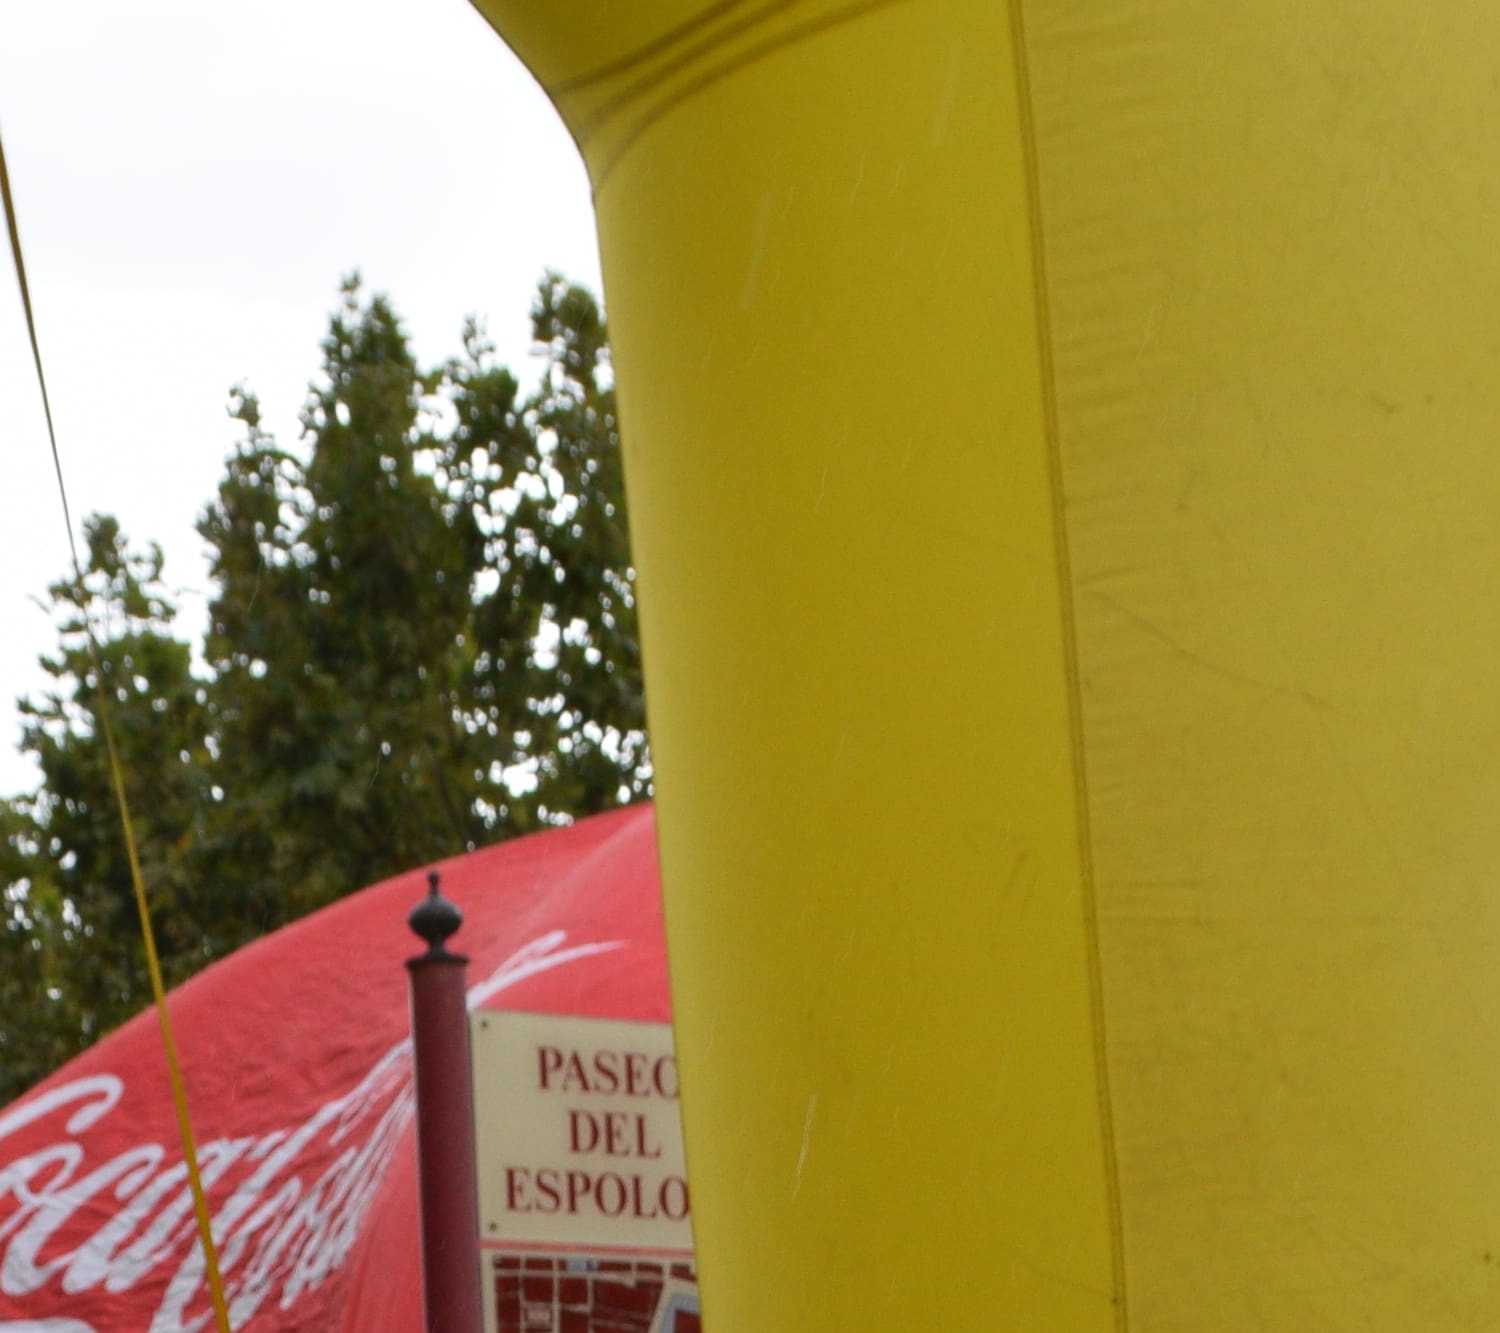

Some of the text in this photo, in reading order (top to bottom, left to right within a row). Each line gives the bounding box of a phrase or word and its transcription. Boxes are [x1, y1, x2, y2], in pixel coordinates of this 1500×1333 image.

[537, 1044, 680, 1099] PASEO
[567, 1110, 663, 1159] DEL
[504, 1168, 691, 1221] ESPOLO
